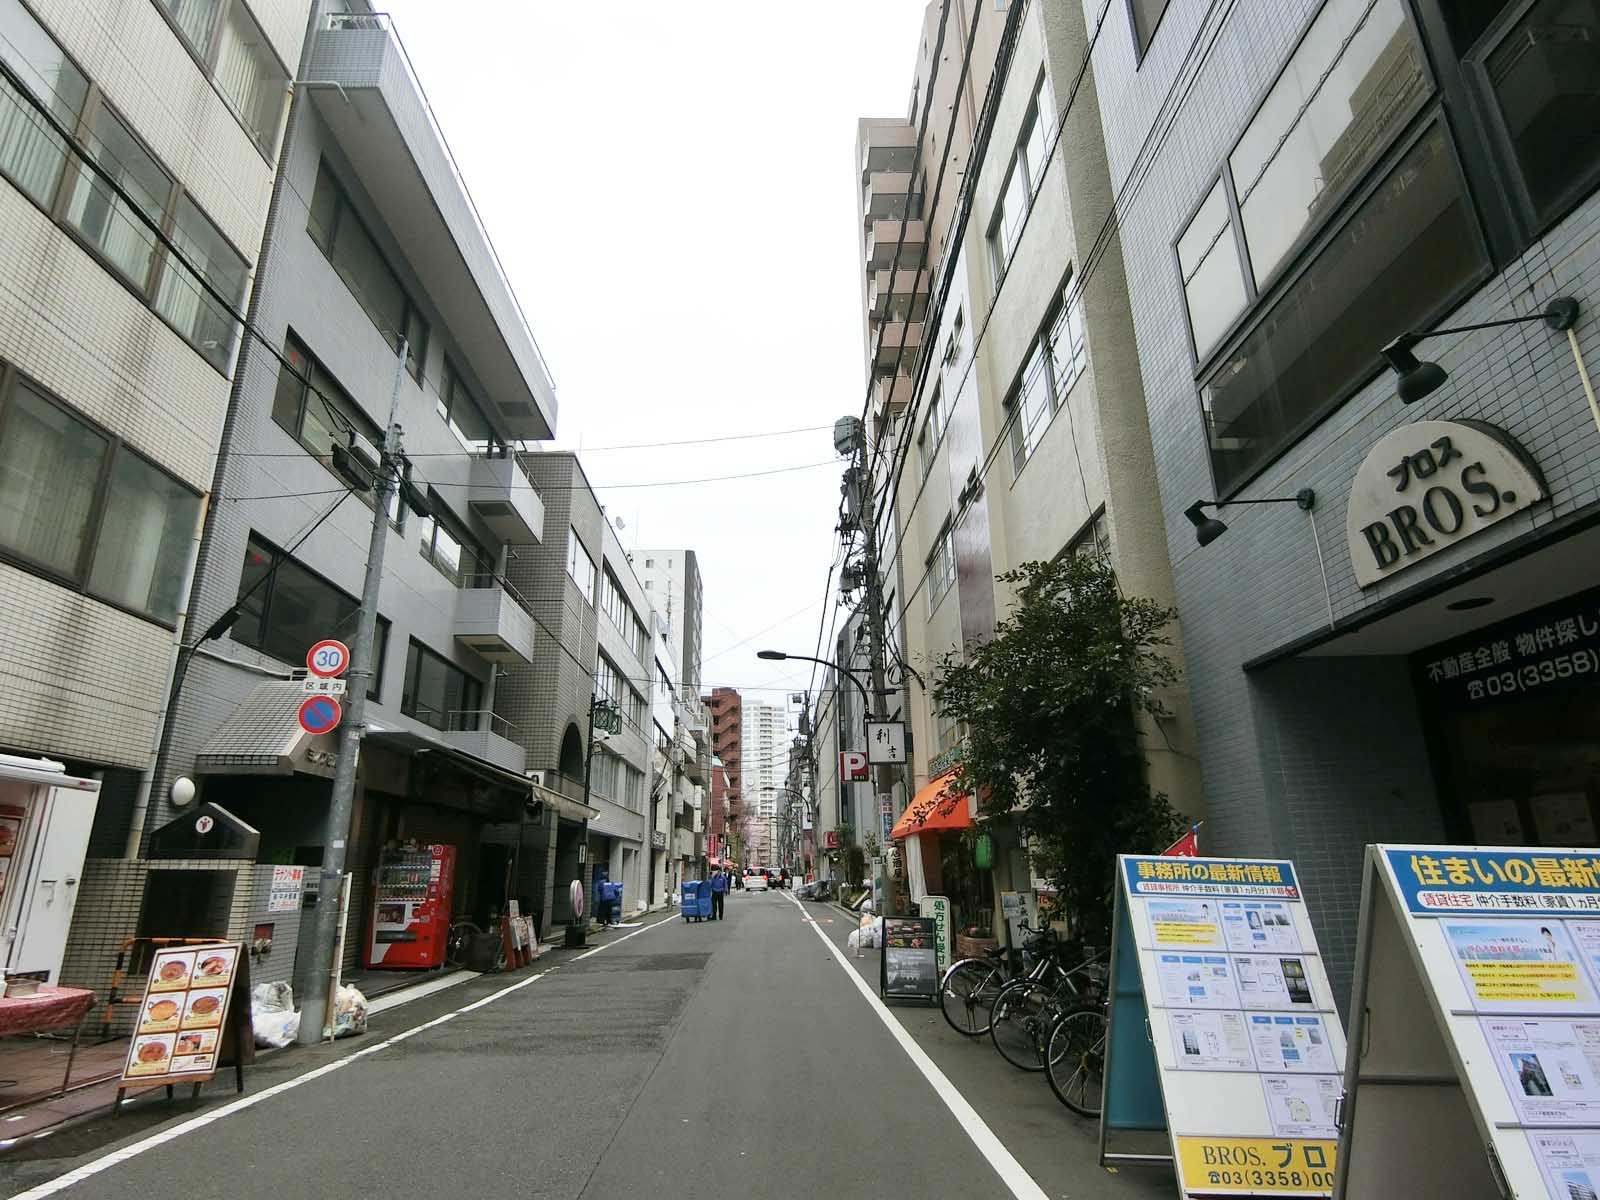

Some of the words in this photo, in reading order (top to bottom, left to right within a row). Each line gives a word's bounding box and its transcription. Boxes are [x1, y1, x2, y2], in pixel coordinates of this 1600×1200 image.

[1386, 435, 1463, 492] ブロス
[1359, 461, 1517, 570] BROS.
[316, 650, 340, 667] 30
[1426, 640, 1512, 683] 不動産全般
[1515, 611, 1600, 656] 物件探し
[1486, 648, 1600, 696] 03(3358)
[304, 681, 343, 691] 区域内
[844, 752, 865, 780] P
[1136, 861, 1283, 883] 事務所の最新情報
[1423, 893, 1474, 907] 賃貸住宅
[1476, 893, 1600, 909] 仲介手数料(家賃1ヵ月
[1202, 1145, 1266, 1166] BROS.
[1272, 1142, 1337, 1169] ブロ
